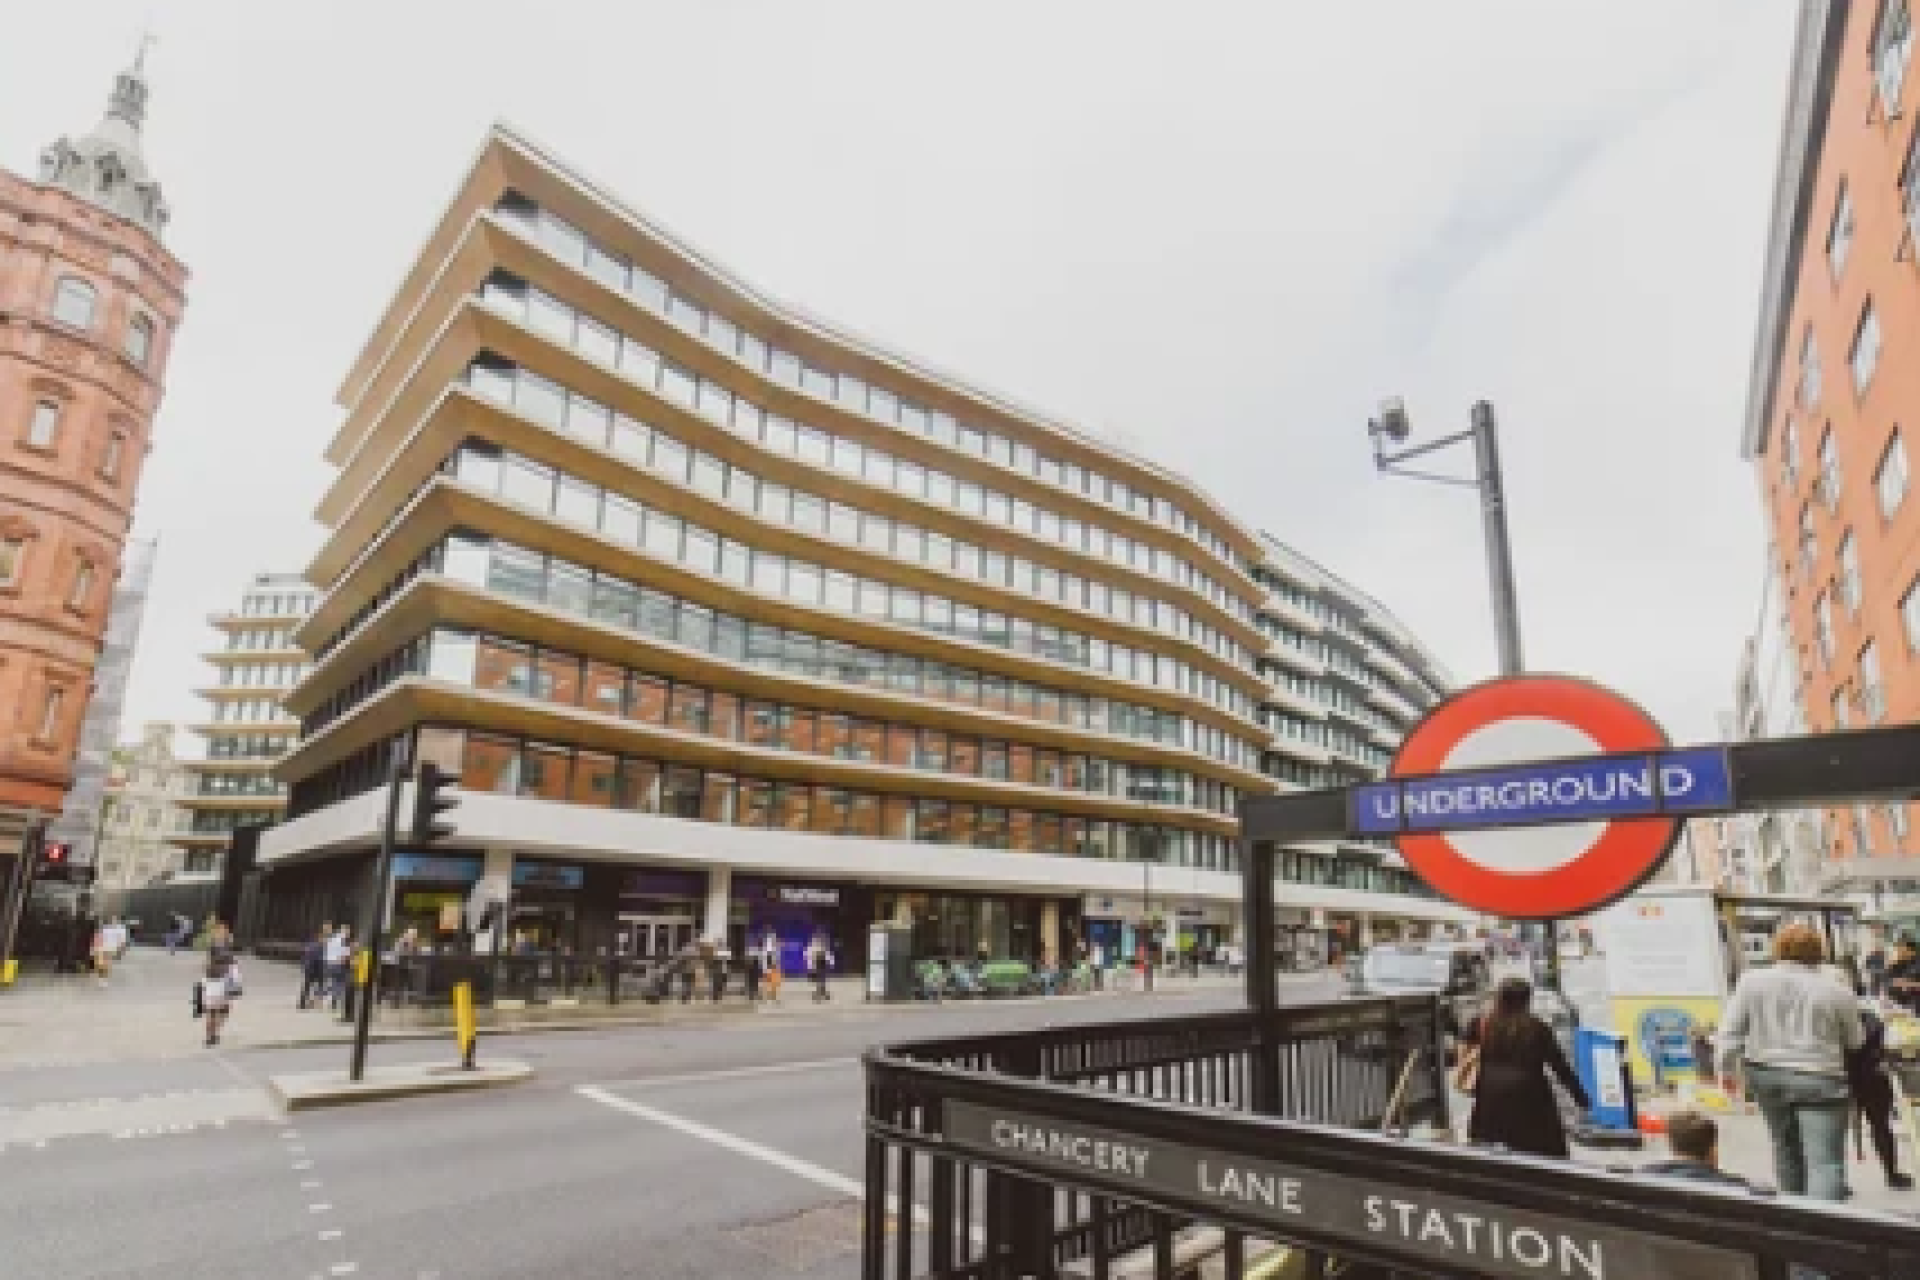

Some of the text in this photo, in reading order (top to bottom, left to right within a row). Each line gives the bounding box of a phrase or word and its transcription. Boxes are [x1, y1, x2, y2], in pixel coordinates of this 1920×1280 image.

[1373, 767, 1693, 819] UNDERGROUND
[991, 1119, 1604, 1280] CHANCERY LANE STATION
